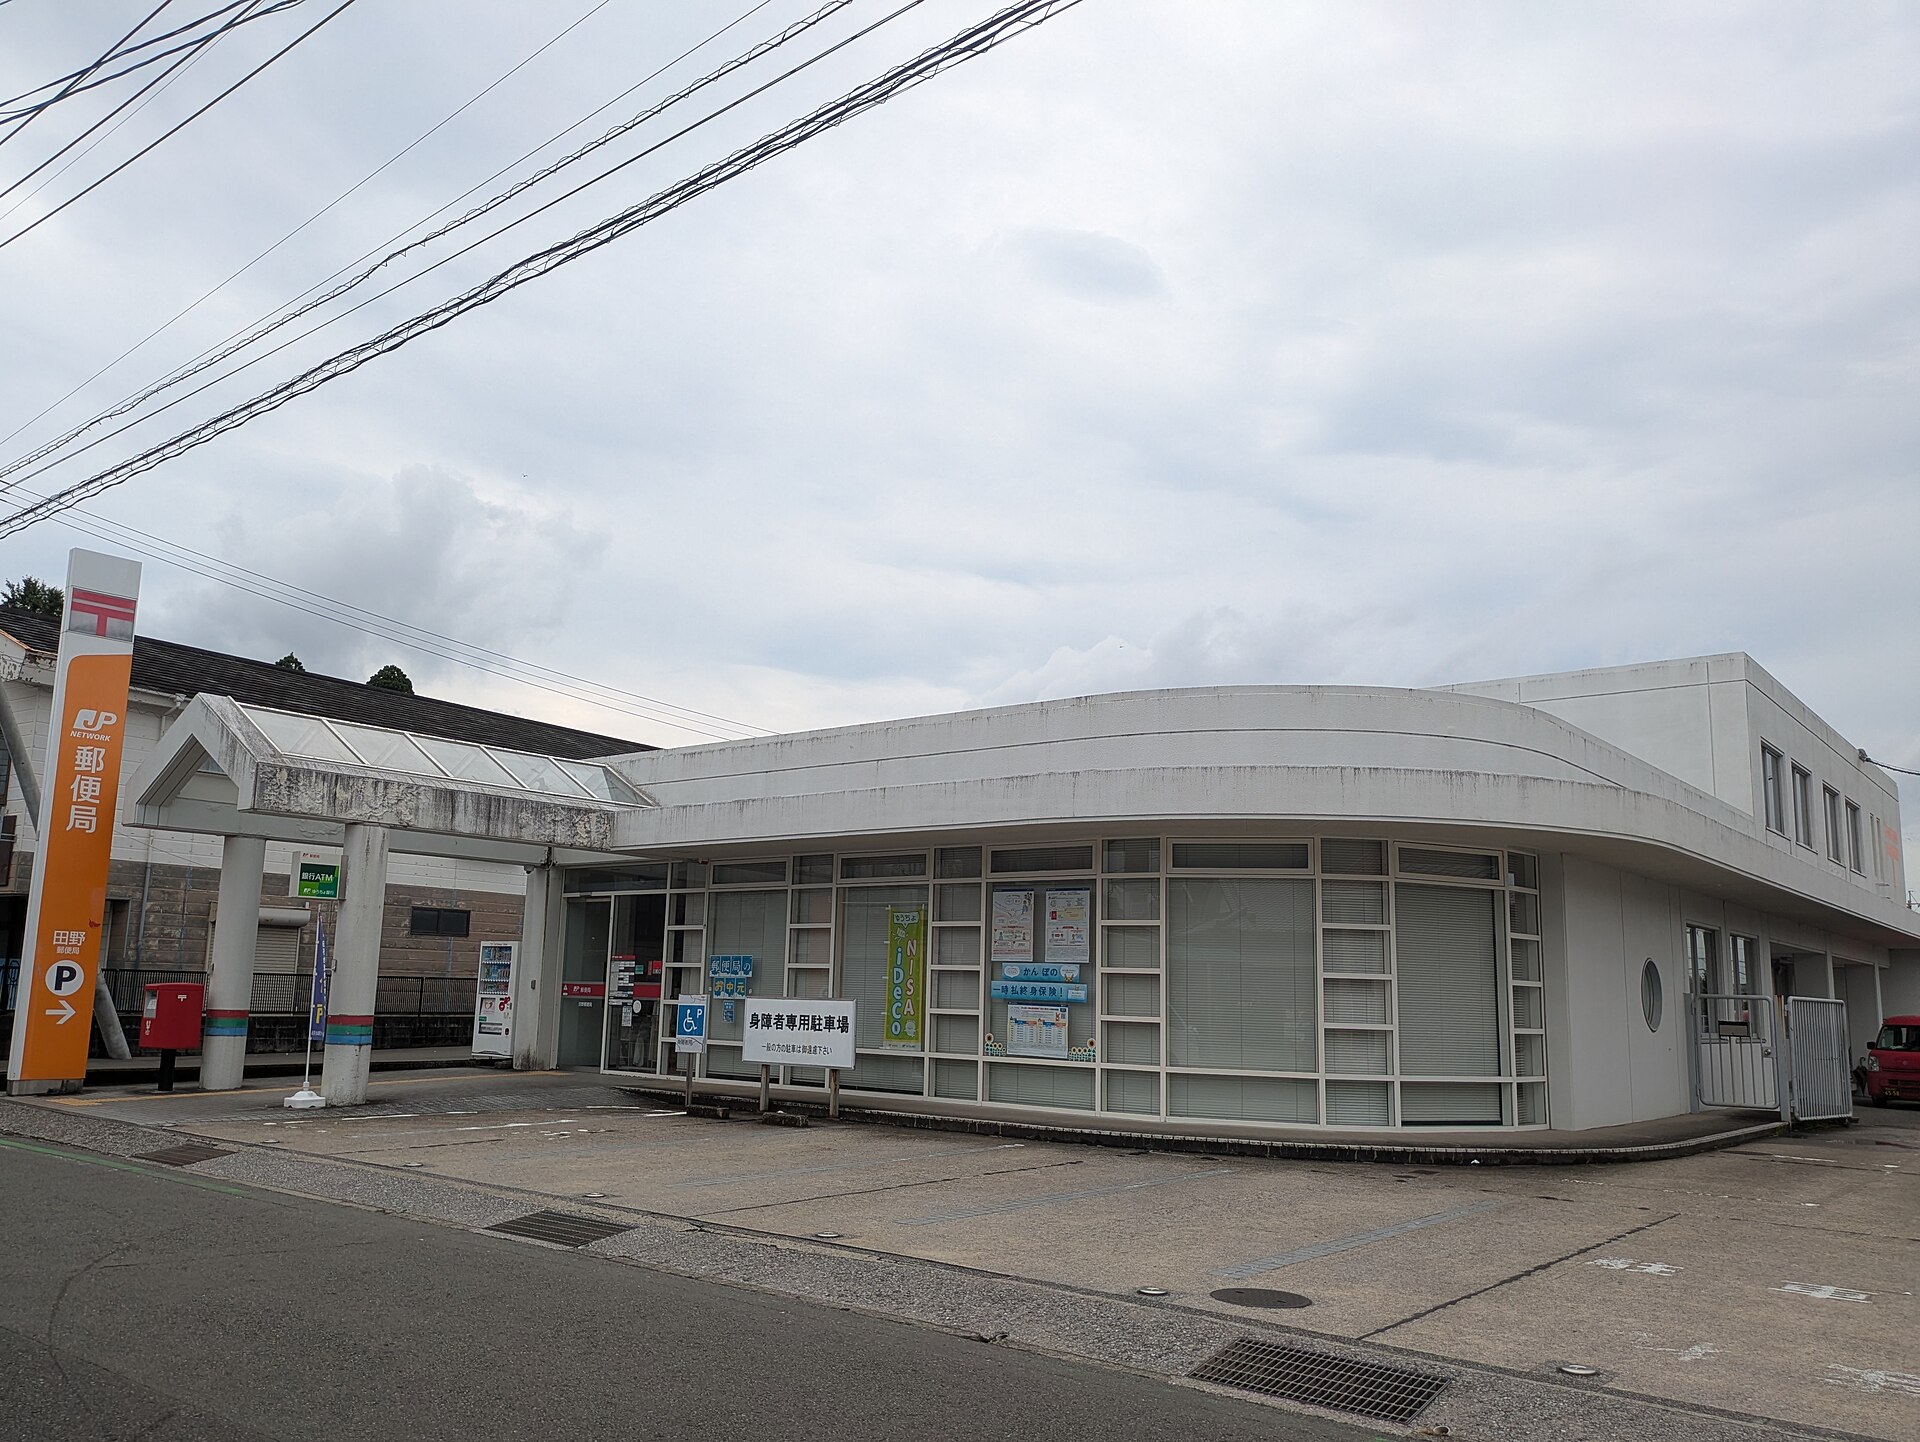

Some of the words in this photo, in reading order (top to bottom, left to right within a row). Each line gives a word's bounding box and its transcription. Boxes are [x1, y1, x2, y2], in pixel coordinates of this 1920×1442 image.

[70, 731, 111, 742] NETWORK
[65, 745, 106, 834] 郵便局
[301, 872, 334, 882] 銀行ATM
[895, 913, 917, 921] ゆうちょ
[53, 930, 86, 946] 田野
[56, 945, 80, 955] 郵便局
[711, 960, 751, 973] 郵便局の
[54, 965, 77, 991] P
[904, 940, 917, 1016] NISA
[714, 980, 745, 993] お中元
[891, 947, 904, 1037] iDeCo
[697, 1008, 703, 1019] P
[749, 1012, 850, 1034] 身障者専用駐車場
